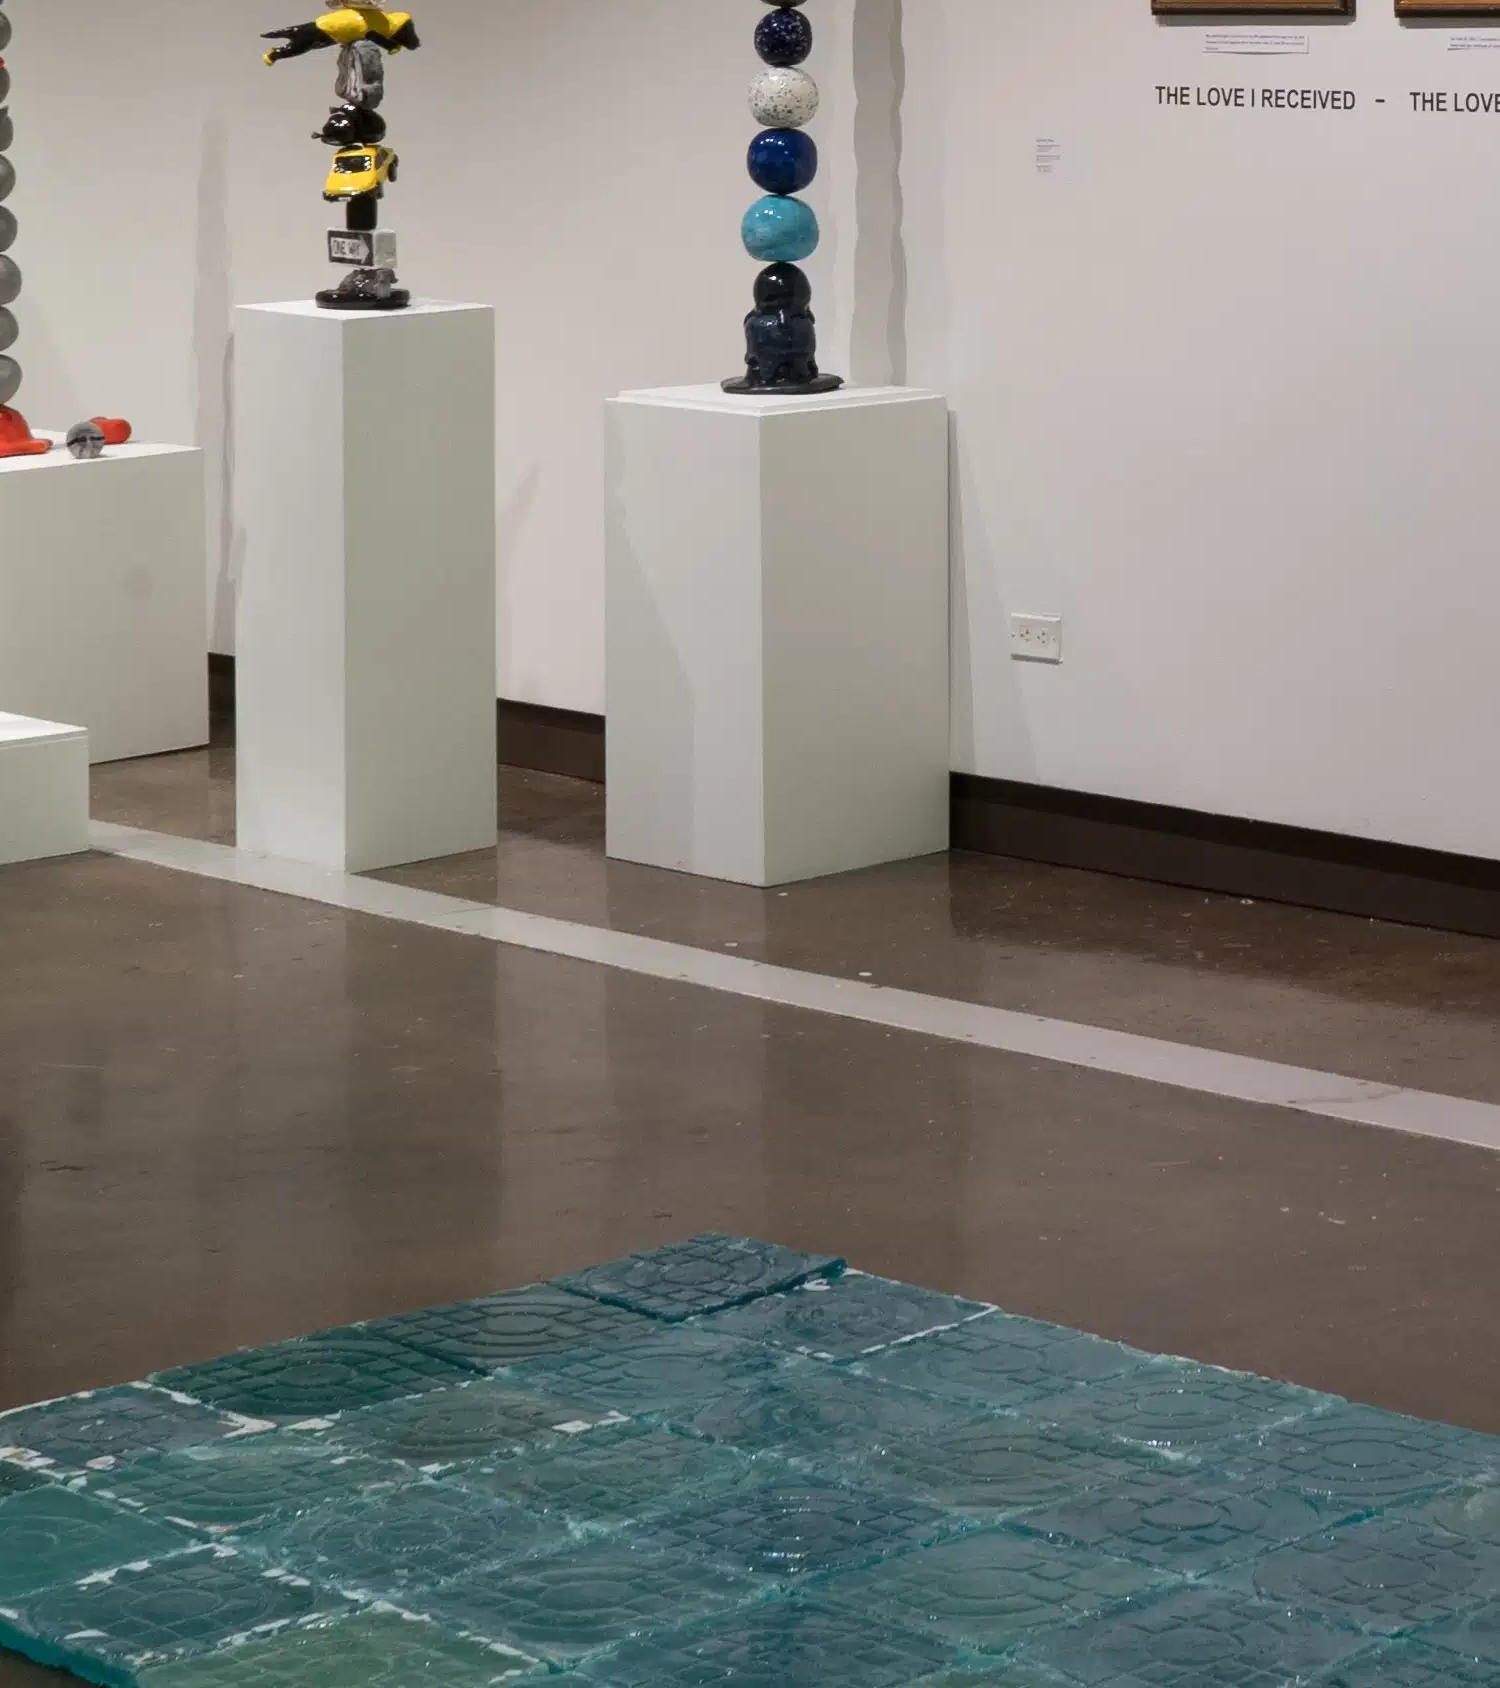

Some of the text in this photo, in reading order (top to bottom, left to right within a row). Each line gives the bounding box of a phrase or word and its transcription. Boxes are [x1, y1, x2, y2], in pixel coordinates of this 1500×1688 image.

[1155, 86, 1189, 106] THE
[1196, 87, 1244, 107] LOVE
[1251, 89, 1255, 108] I
[1261, 89, 1355, 110] RECEIVED
[1410, 92, 1446, 111] THE
